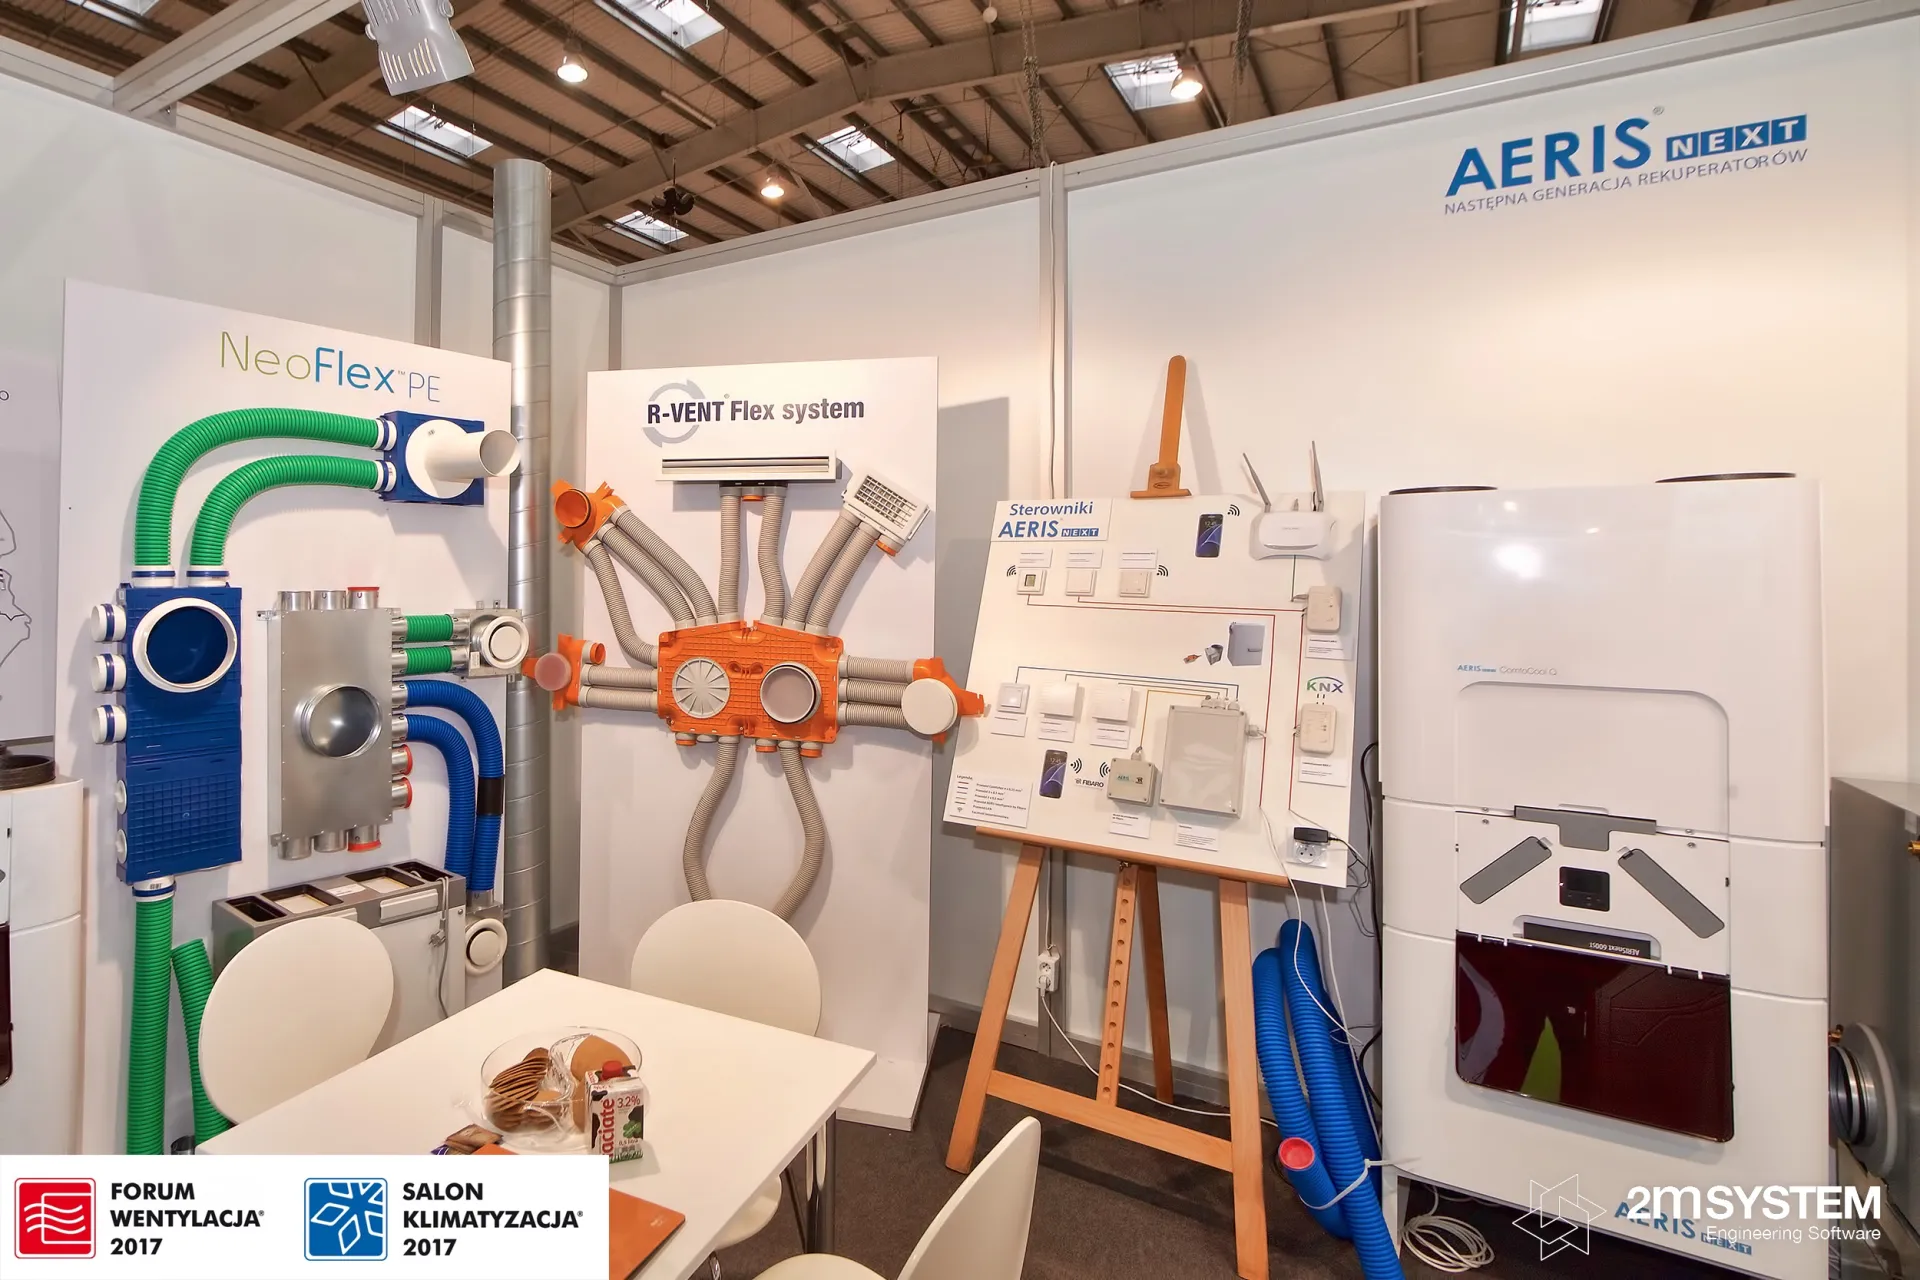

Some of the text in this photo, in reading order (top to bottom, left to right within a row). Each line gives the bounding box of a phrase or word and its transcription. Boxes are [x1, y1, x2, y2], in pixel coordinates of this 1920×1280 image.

[1670, 118, 1801, 160] NEXT
[1444, 148, 1808, 215] NASTĘPNA GENERACJA REKUPERATORÓW
[408, 371, 441, 403] PE
[730, 400, 775, 421] Flex
[782, 398, 865, 425] system
[1009, 501, 1094, 516] Sterowniki
[998, 520, 1099, 538] AERIS NEXT
[1306, 680, 1344, 694] KNX
[1082, 779, 1104, 788] FIBARO
[598, 1098, 615, 1158] aciate
